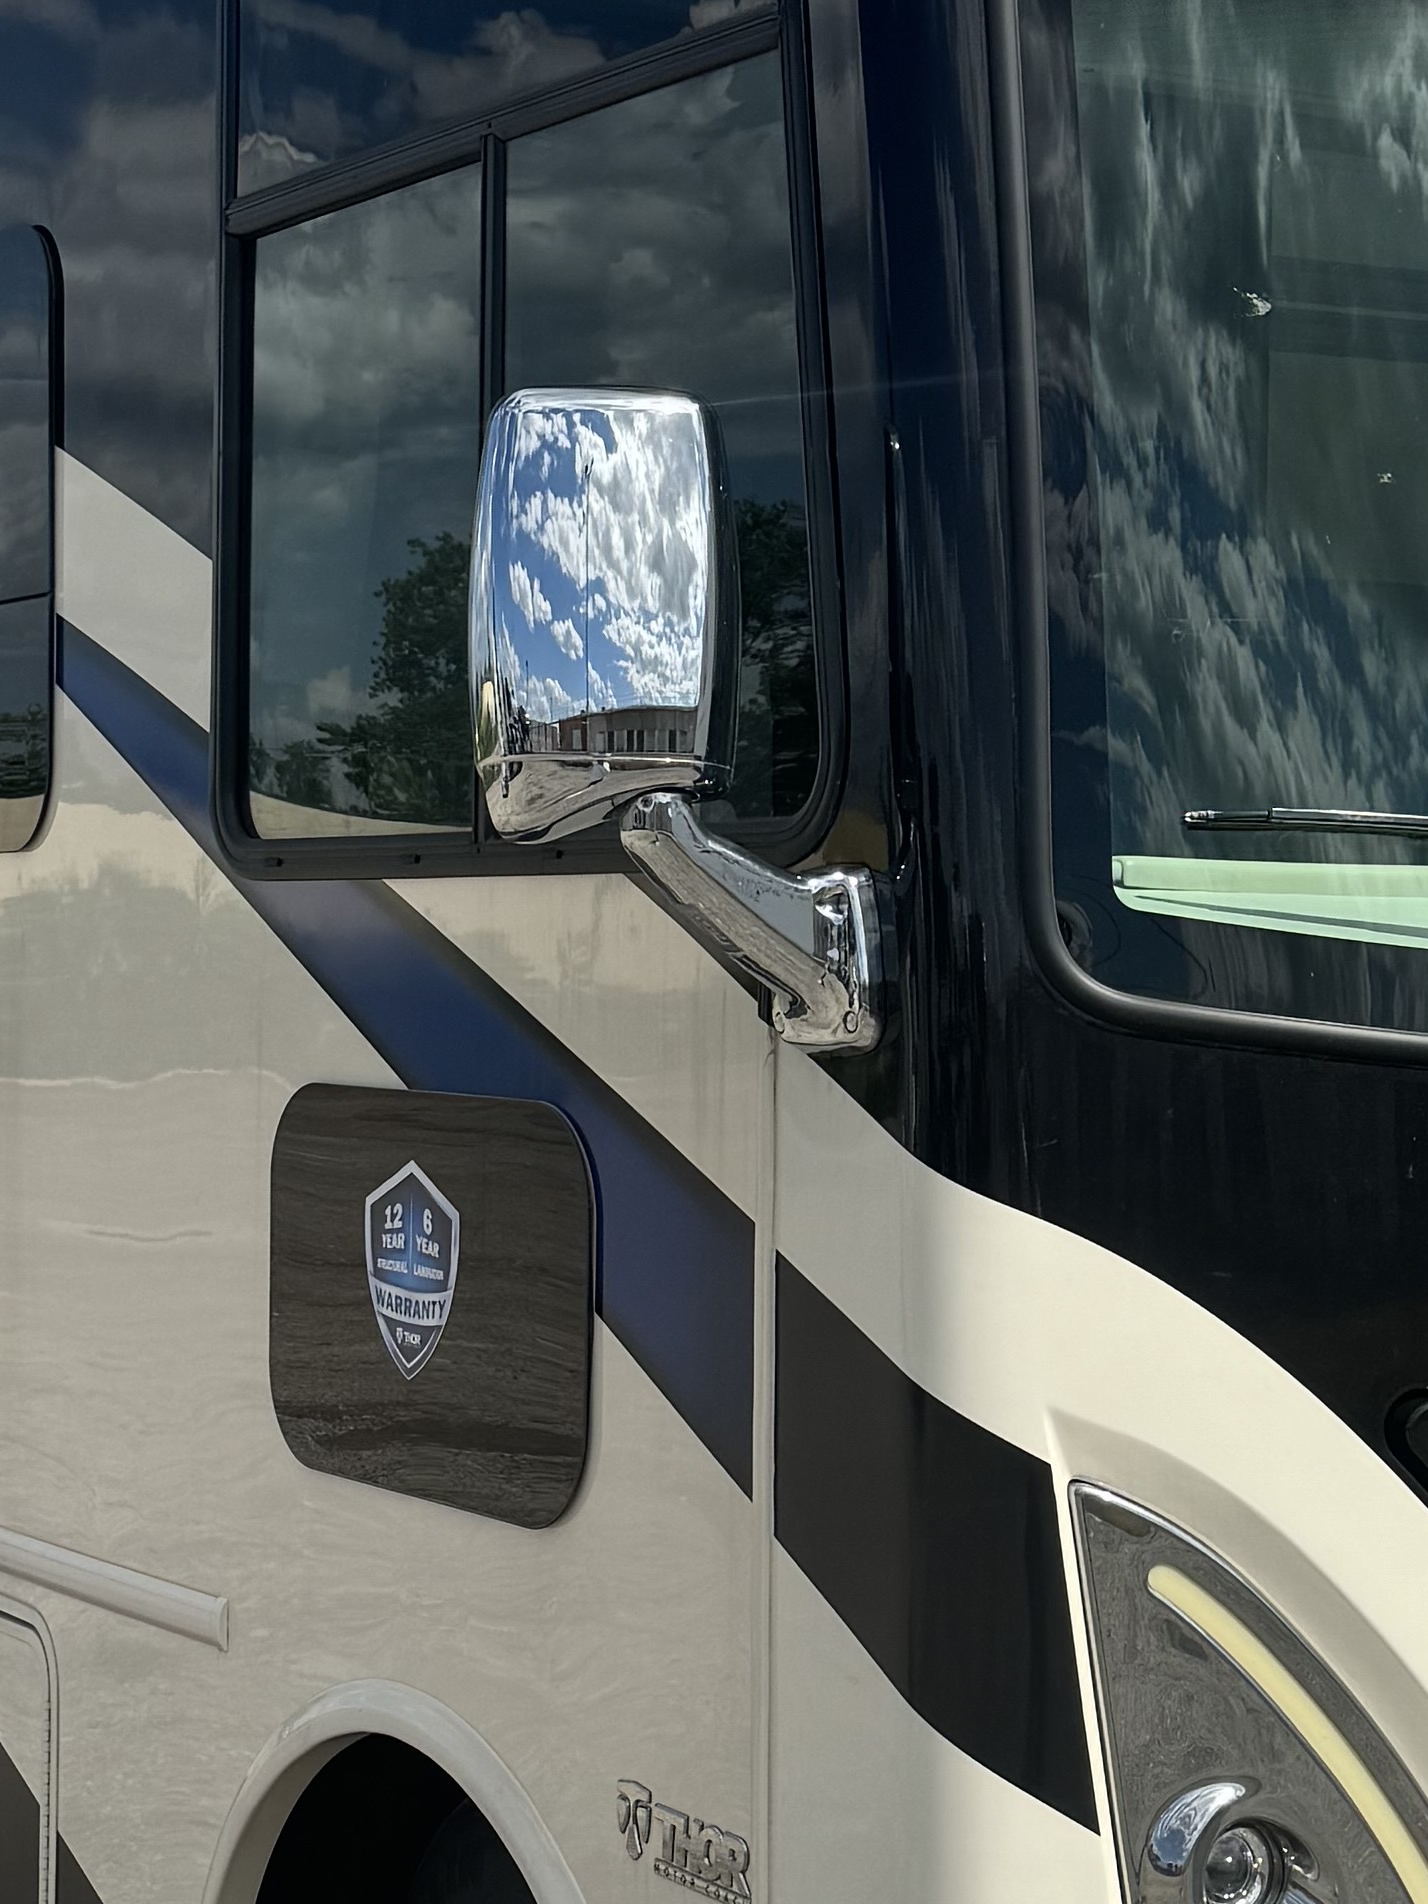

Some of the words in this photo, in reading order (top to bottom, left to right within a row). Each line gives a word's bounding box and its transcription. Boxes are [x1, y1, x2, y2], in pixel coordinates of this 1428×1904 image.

[384, 1203, 403, 1229] 12
[422, 1208, 433, 1235] 6
[382, 1233, 405, 1249] YEAR
[416, 1235, 440, 1258] YEAR
[375, 1284, 446, 1321] WARRANTY
[652, 1802, 752, 1897] THOR
